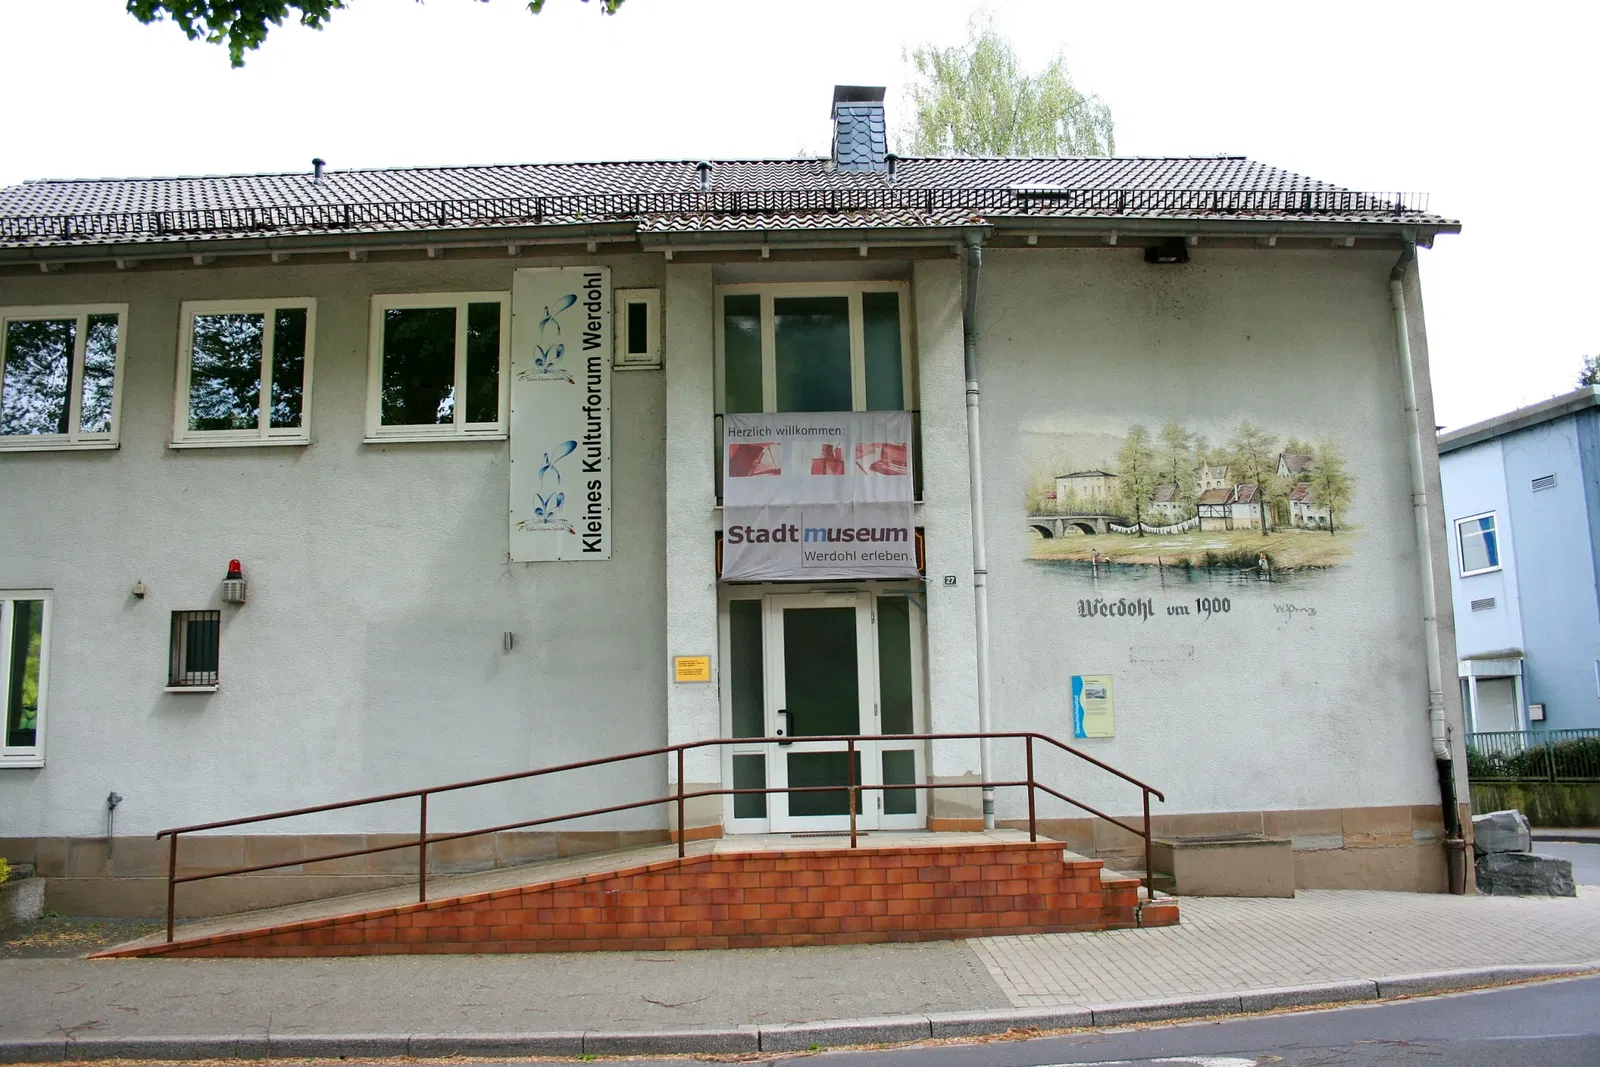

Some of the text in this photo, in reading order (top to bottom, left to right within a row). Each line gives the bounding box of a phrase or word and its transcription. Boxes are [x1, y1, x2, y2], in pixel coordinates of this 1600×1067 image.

[582, 272, 602, 553] Kleines Kulturforum Werdohl
[728, 425, 845, 438] Herzlich willkommen:
[804, 550, 913, 561] Werdohl erleben.
[946, 576, 955, 584] 27
[1077, 597, 1155, 623] Werdohl
[1195, 597, 1231, 623] 1900
